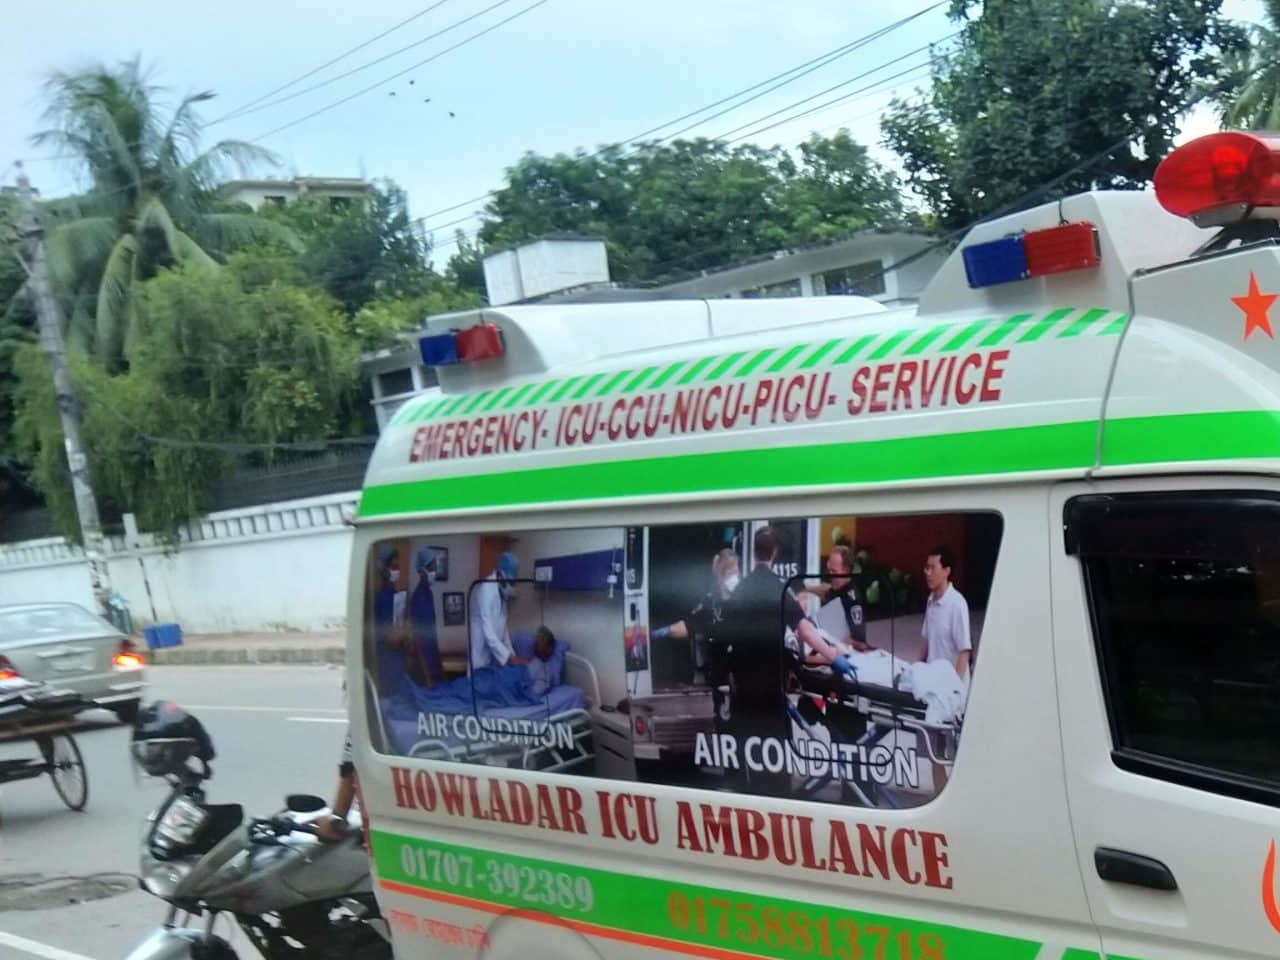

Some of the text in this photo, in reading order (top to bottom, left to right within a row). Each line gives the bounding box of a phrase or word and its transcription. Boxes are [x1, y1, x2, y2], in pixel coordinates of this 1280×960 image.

[848, 348, 1011, 417] SERVICE
[417, 711, 576, 750] AIR CONDITION
[694, 732, 919, 789] AIR CONDITION
[390, 766, 954, 890] HOWLADAR ICU AMBULANCE
[400, 843, 596, 913] 01707-392389
